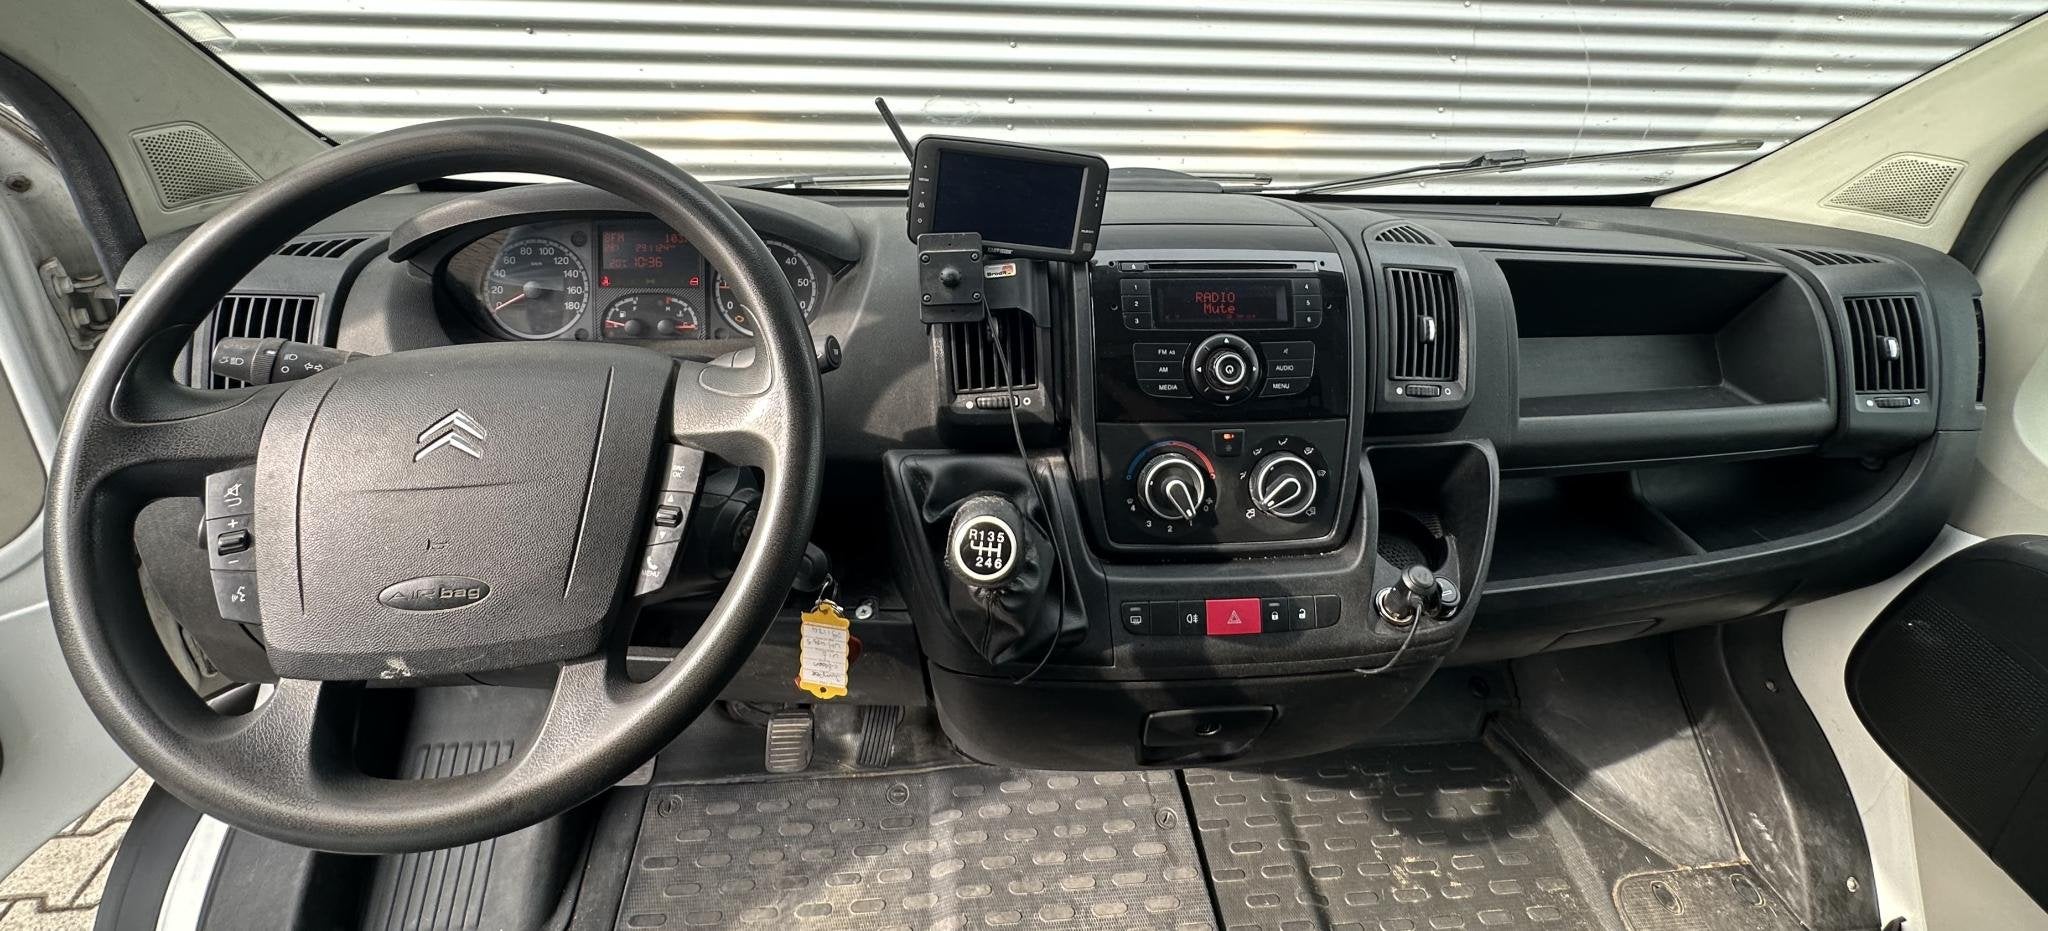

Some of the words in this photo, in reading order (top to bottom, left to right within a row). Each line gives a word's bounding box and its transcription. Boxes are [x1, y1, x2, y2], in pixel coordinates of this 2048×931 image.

[520, 247, 532, 255] 80
[540, 247, 554, 255] 100
[504, 256, 516, 264] 60
[554, 256, 570, 264] 120
[786, 256, 798, 266] 40
[494, 270, 506, 278] 40
[564, 270, 578, 278] 140
[798, 278, 809, 286] 50
[491, 286, 504, 294] 20
[567, 286, 582, 294] 160
[1195, 292, 1236, 302] RADIO
[564, 302, 580, 310] 180
[727, 300, 734, 310] 0
[800, 300, 806, 308] 0
[1204, 304, 1236, 314] Mute
[969, 528, 978, 540] R
[979, 530, 985, 541] 1
[987, 532, 995, 542] 3
[996, 532, 1005, 542] 5
[975, 556, 983, 567] 2
[984, 558, 992, 568] 4
[994, 558, 1002, 569] 6
